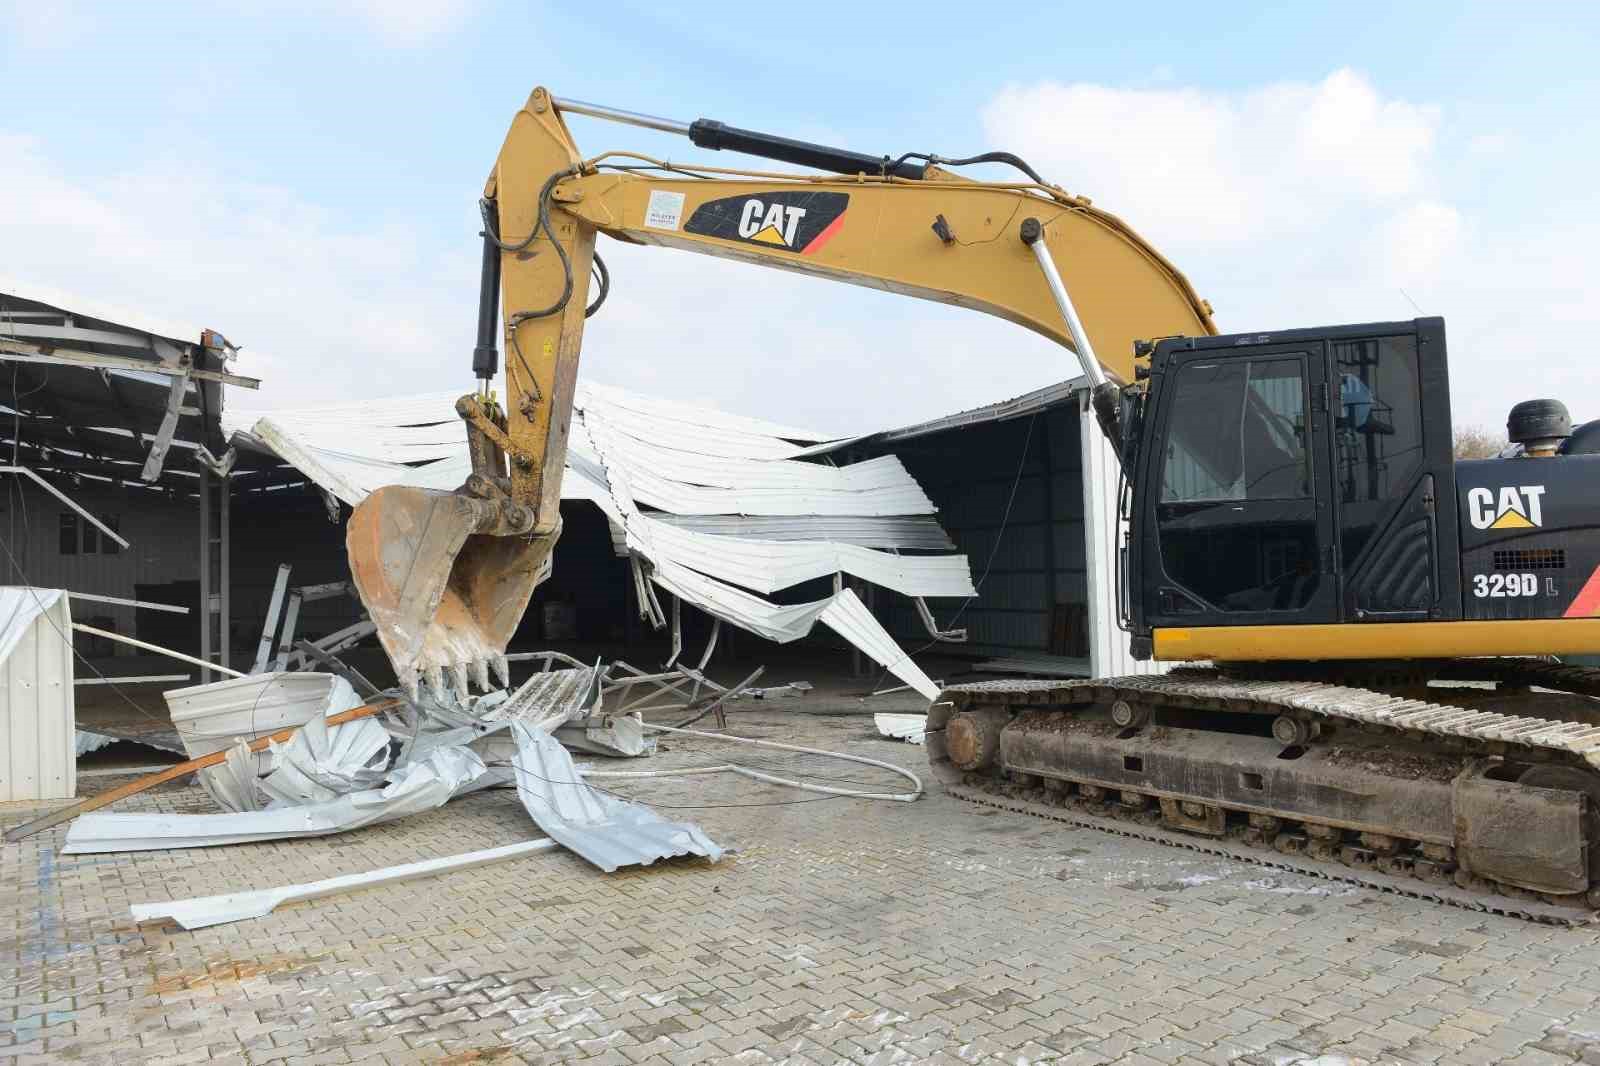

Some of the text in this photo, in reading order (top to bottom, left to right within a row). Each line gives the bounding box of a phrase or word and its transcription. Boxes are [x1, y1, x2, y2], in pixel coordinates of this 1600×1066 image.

[738, 199, 806, 247] CAT
[1467, 485, 1545, 529] CAT
[1473, 573, 1559, 597] 329D L
